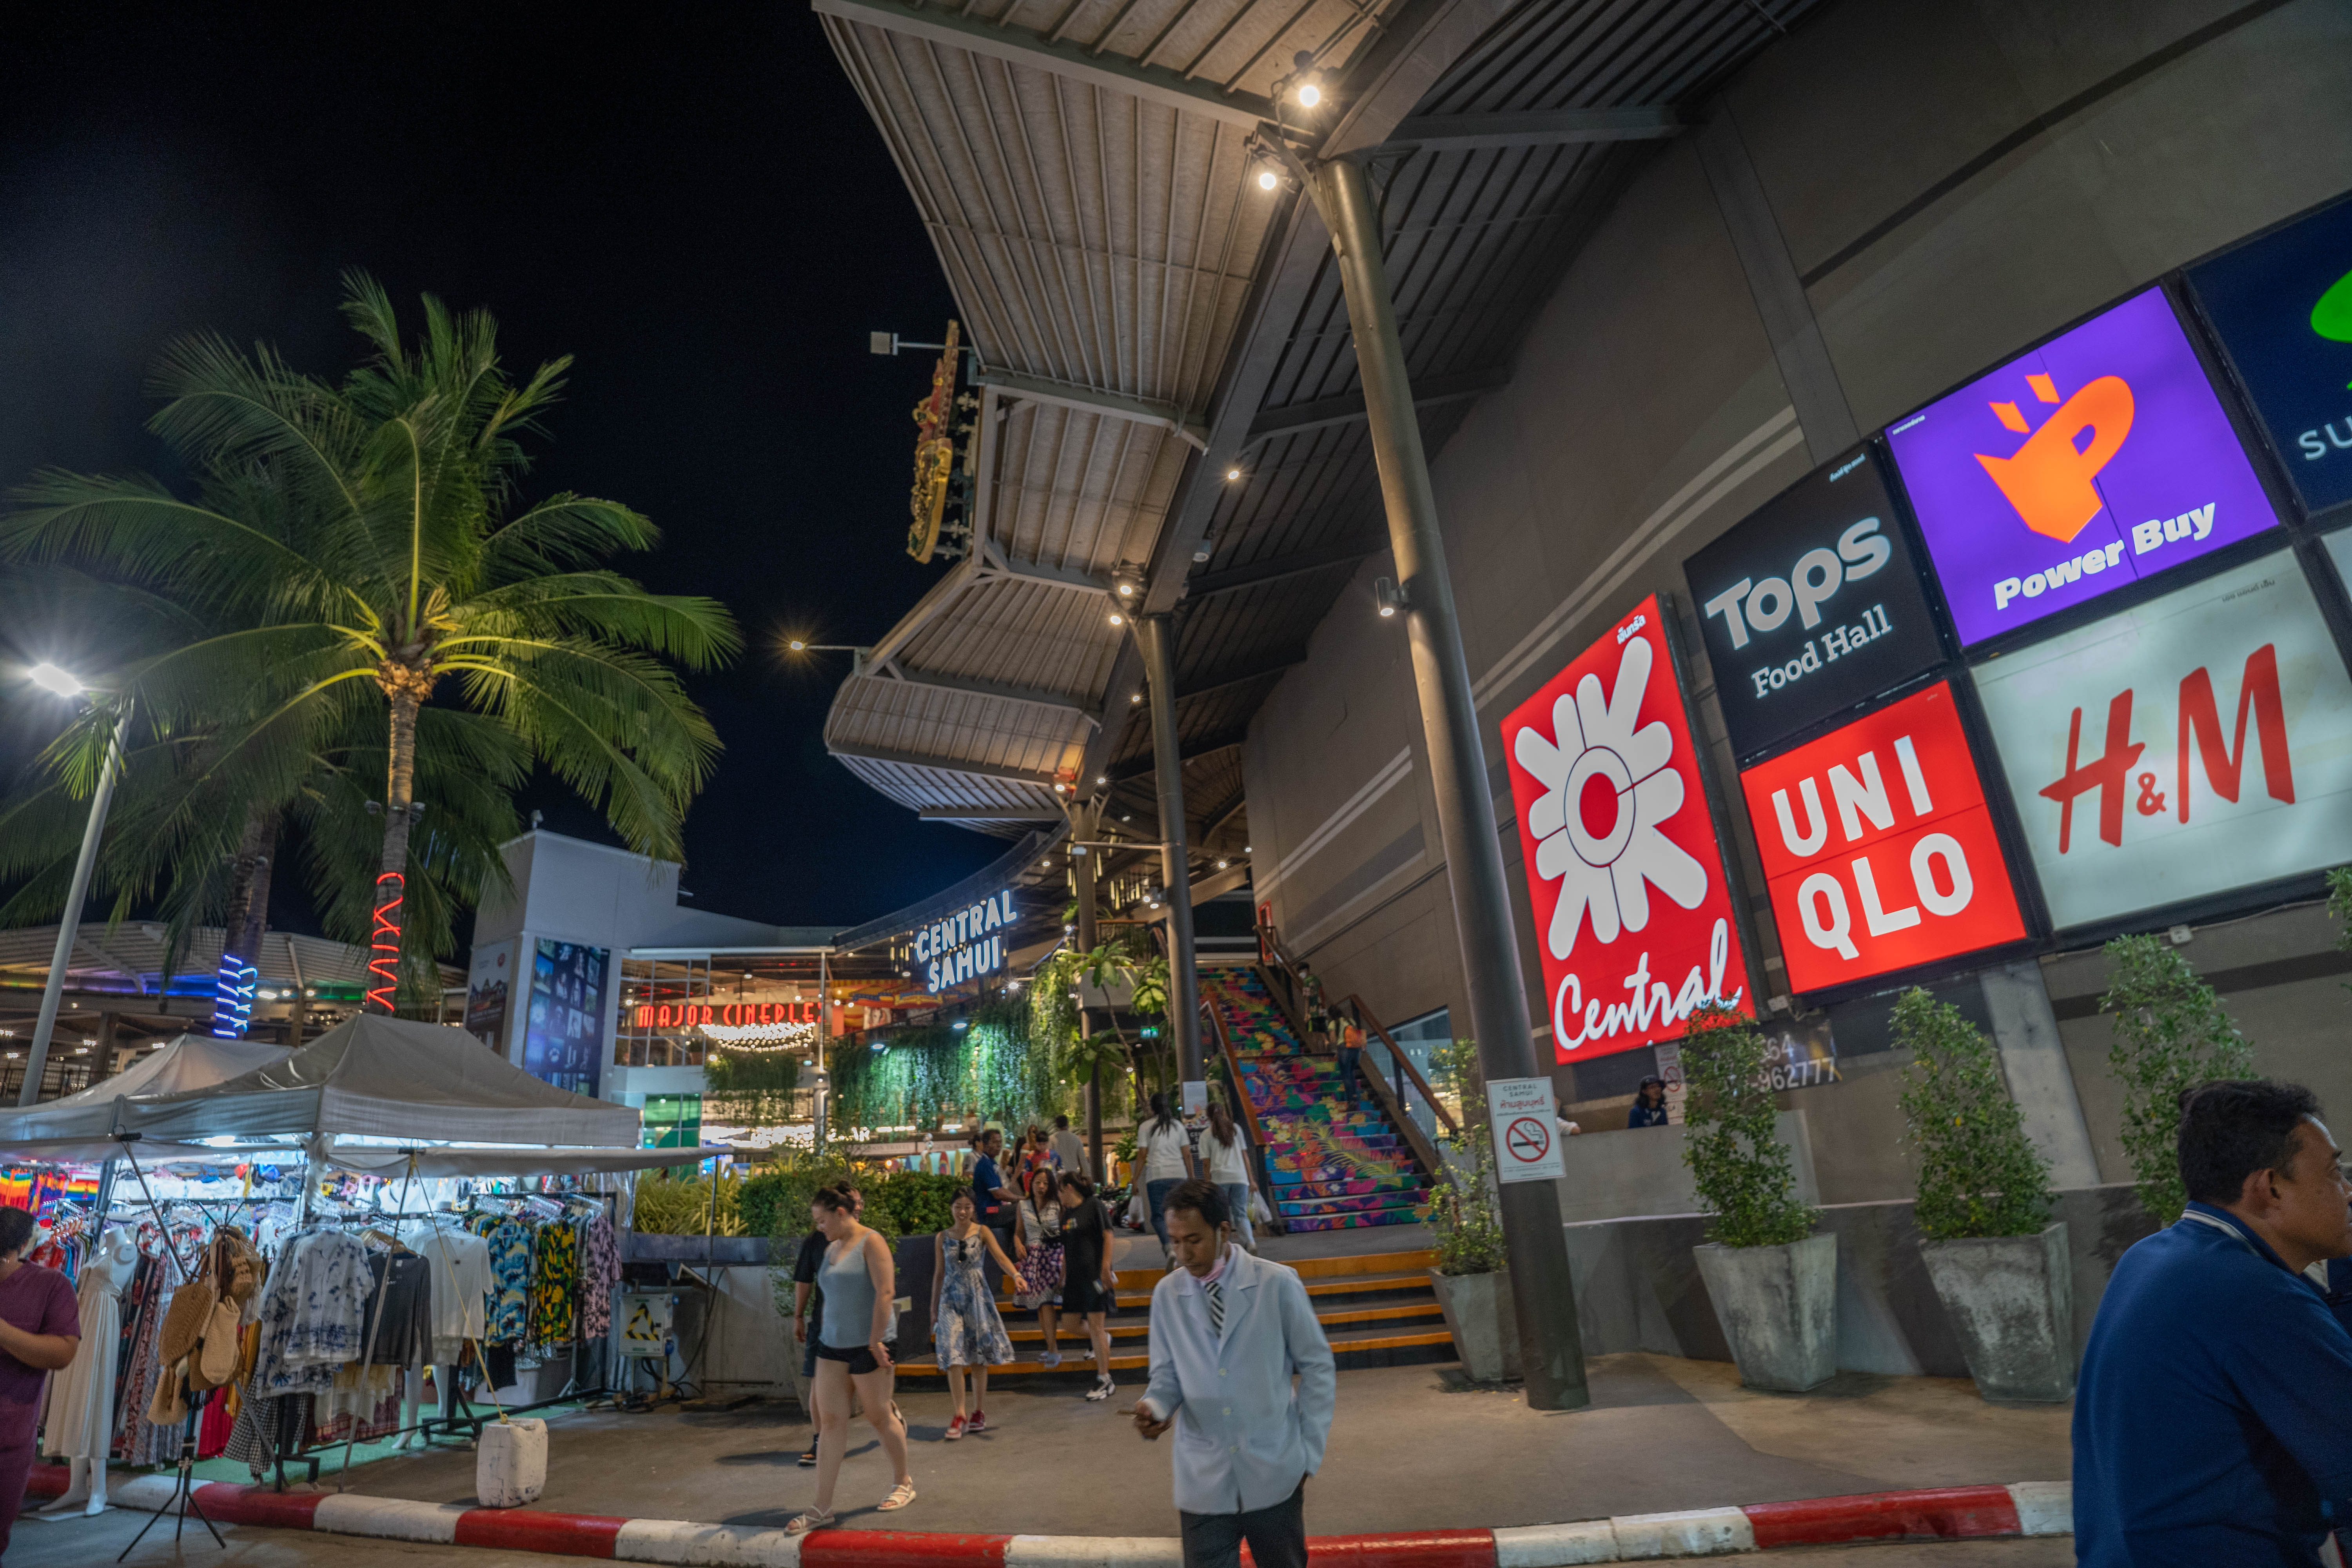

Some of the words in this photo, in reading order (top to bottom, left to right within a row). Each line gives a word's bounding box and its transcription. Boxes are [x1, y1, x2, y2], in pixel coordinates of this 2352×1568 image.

[1993, 539, 2125, 611] Power
[2131, 502, 2216, 555] Buy
[1751, 641, 1822, 698] Food
[1820, 604, 1892, 662] Hall
[1771, 735, 1934, 858] UNI
[2039, 643, 2296, 854] H&M
[915, 889, 1017, 962] CENTRAL
[1797, 832, 1974, 961] QLO
[928, 935, 999, 993] SAMUI
[1554, 917, 1743, 1051] Central
[638, 1004, 713, 1028] MAJOR
[1503, 1083, 1537, 1092] CENTRAL
